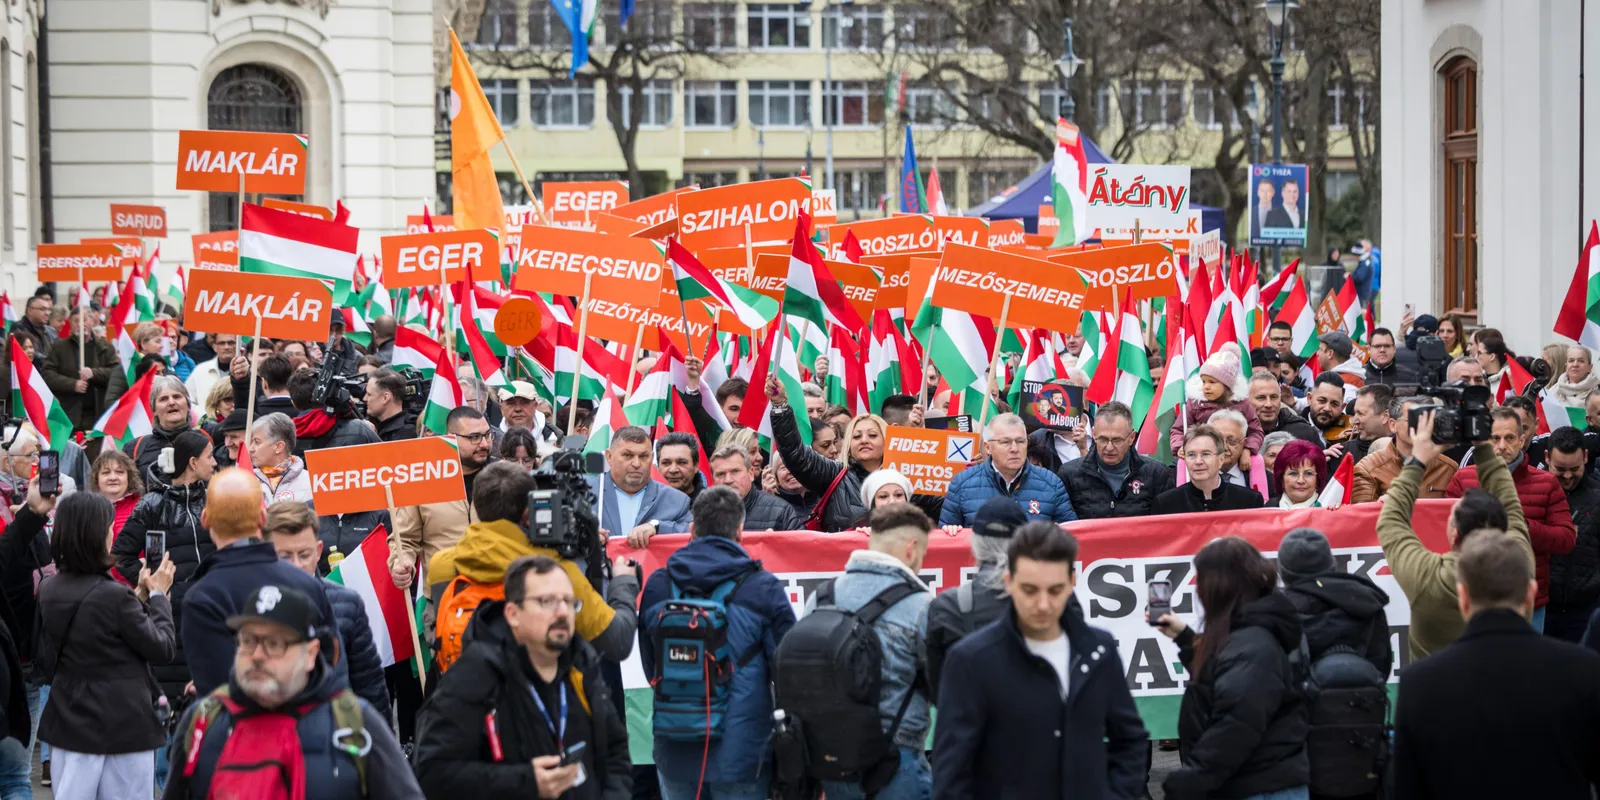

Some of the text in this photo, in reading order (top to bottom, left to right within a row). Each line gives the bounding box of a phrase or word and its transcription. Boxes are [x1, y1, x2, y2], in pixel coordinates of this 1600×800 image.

[185, 148, 298, 176] MAKLÁR
[1272, 168, 1291, 176] TISZA
[1088, 167, 1187, 214] Átány
[554, 190, 617, 212] EGER
[812, 192, 832, 211] ÓK
[115, 212, 163, 230] SARUD
[636, 203, 677, 226] GYTÁ
[681, 198, 811, 234] SZIHALOM
[937, 228, 978, 247] VAJ
[988, 230, 1025, 247] ZALÓK
[122, 243, 141, 258] ÉN
[397, 242, 483, 273] EGER
[38, 254, 122, 268] EGERSZÓLÁT
[519, 248, 661, 282] KERECSEND
[1088, 256, 1173, 288] ROSZLÓ
[938, 266, 1083, 310] MEZŐSZEMERE
[194, 290, 323, 322] MAKLÁR
[500, 311, 535, 331] EGER
[579, 298, 710, 338] MEZŐTÁRKÁNY
[1023, 381, 1043, 394] STOP
[956, 415, 969, 432] ORÚ
[1050, 413, 1080, 427] HÁBORÚ
[888, 437, 939, 454] FIDESZ
[313, 459, 459, 493] KERECSEND
[900, 462, 953, 479] BIZTOS
[913, 478, 951, 492] ASZT
